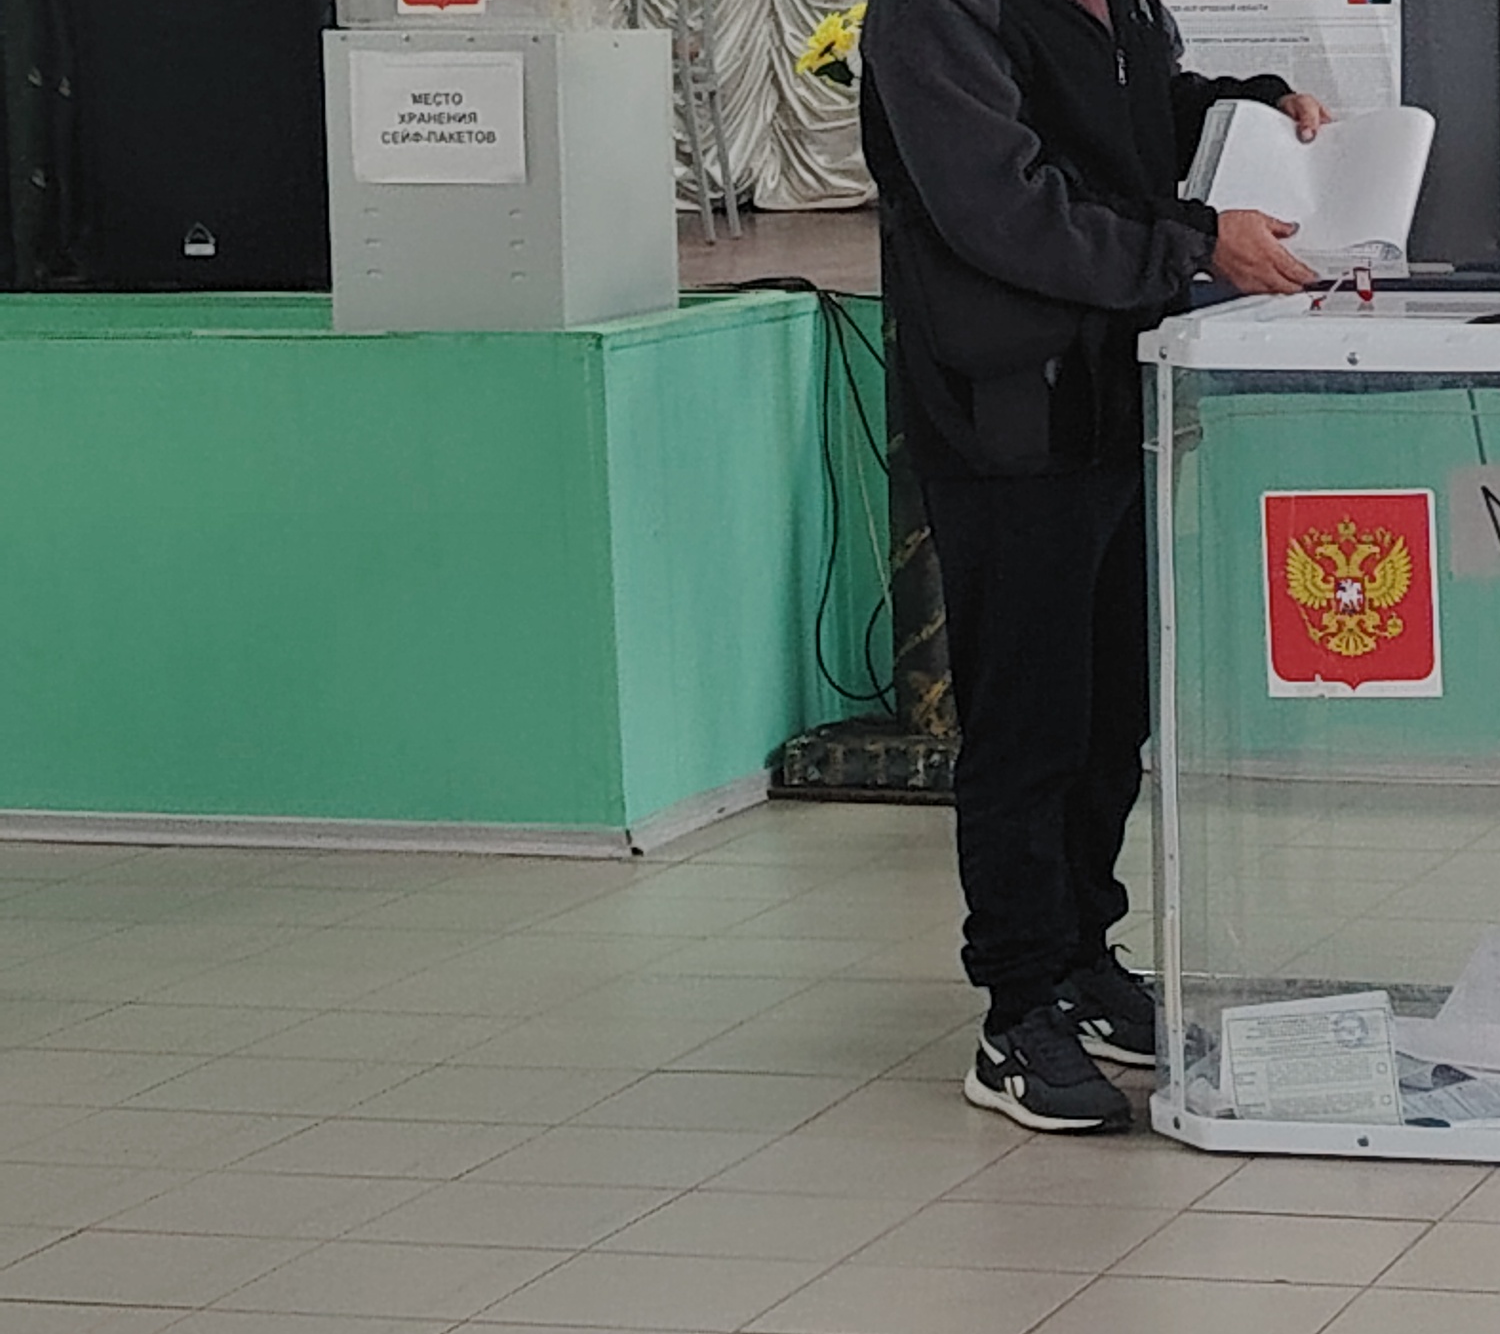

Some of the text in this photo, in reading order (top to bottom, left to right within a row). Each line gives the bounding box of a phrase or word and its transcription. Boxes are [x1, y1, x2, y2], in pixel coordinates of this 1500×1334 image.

[410, 92, 463, 107] МЕСТО
[397, 111, 478, 125] ХРАНЕНИЯ
[381, 128, 496, 145] СЕЙФ-ПАКЕТОВ
